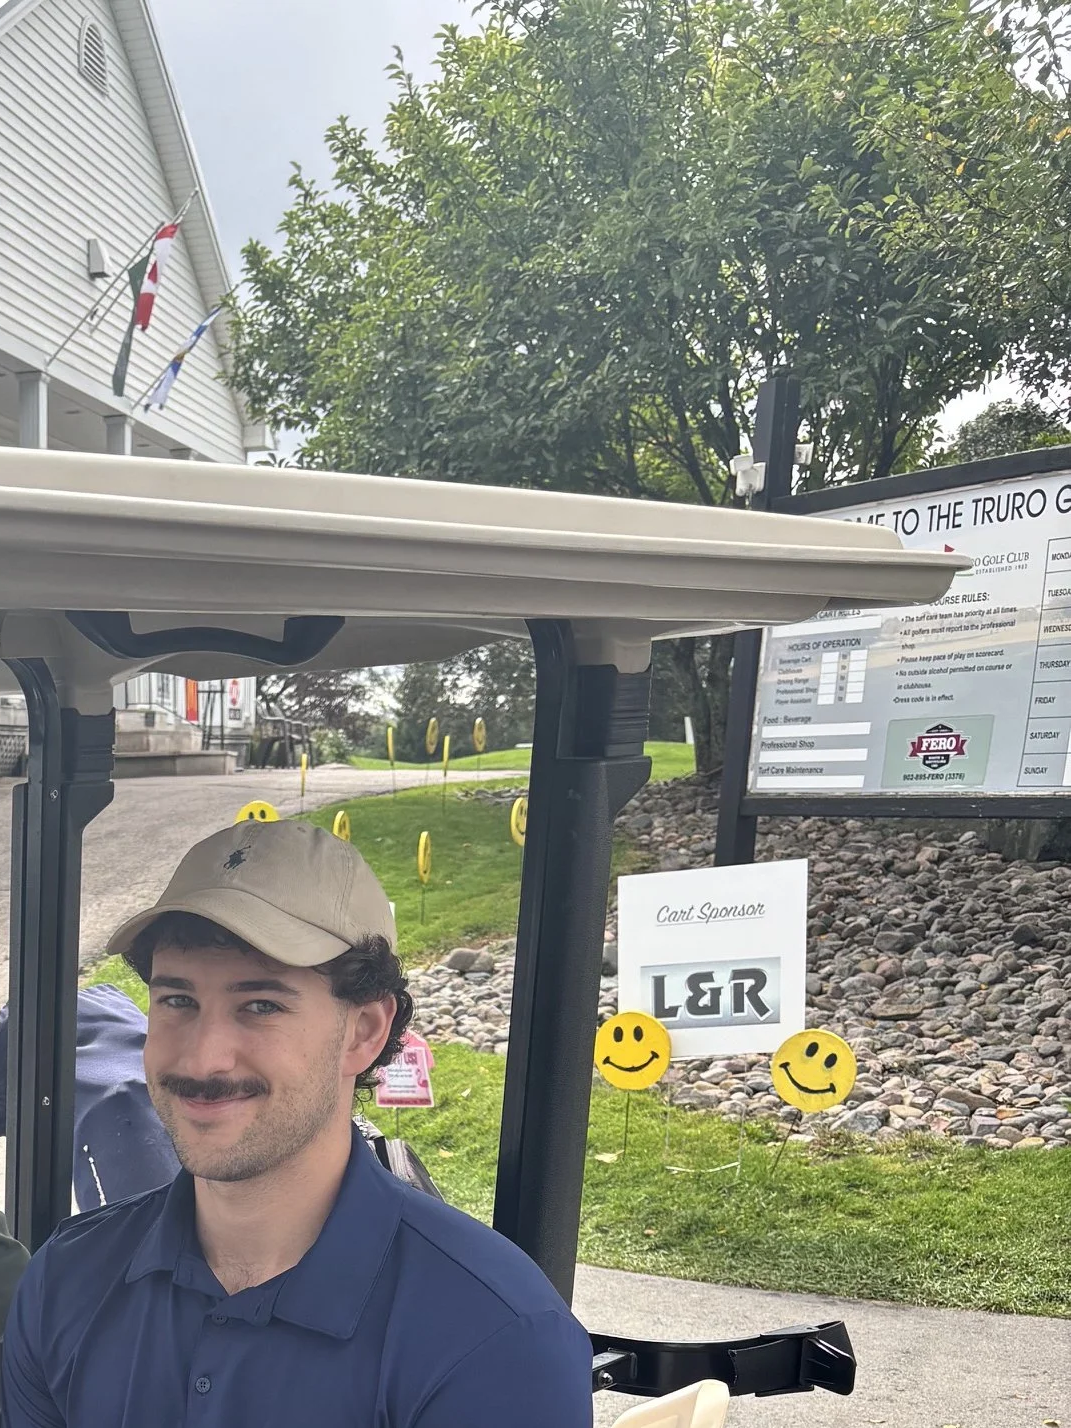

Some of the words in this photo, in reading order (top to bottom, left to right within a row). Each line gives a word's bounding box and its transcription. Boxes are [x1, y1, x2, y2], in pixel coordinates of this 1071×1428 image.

[892, 508, 920, 536] TO
[927, 501, 965, 533] THE
[972, 488, 1047, 526] TRURO
[929, 595, 960, 606] OURSE
[961, 592, 990, 603] RULES:
[965, 609, 985, 618] priority
[980, 619, 1016, 631] professional
[812, 641, 821, 649] OF
[822, 638, 862, 649] OPERATION
[1038, 659, 1071, 669] THURSDAY
[1034, 696, 1056, 704] FRIDAY
[1029, 731, 1060, 740] SATURDAY
[760, 741, 797, 749] Professional
[799, 740, 815, 749] Shop
[921, 736, 957, 751] FERO
[1023, 767, 1048, 775] SUNDAY
[657, 905, 694, 923] Cart
[697, 901, 765, 924] Sponsor
[652, 967, 772, 1021] L&R
